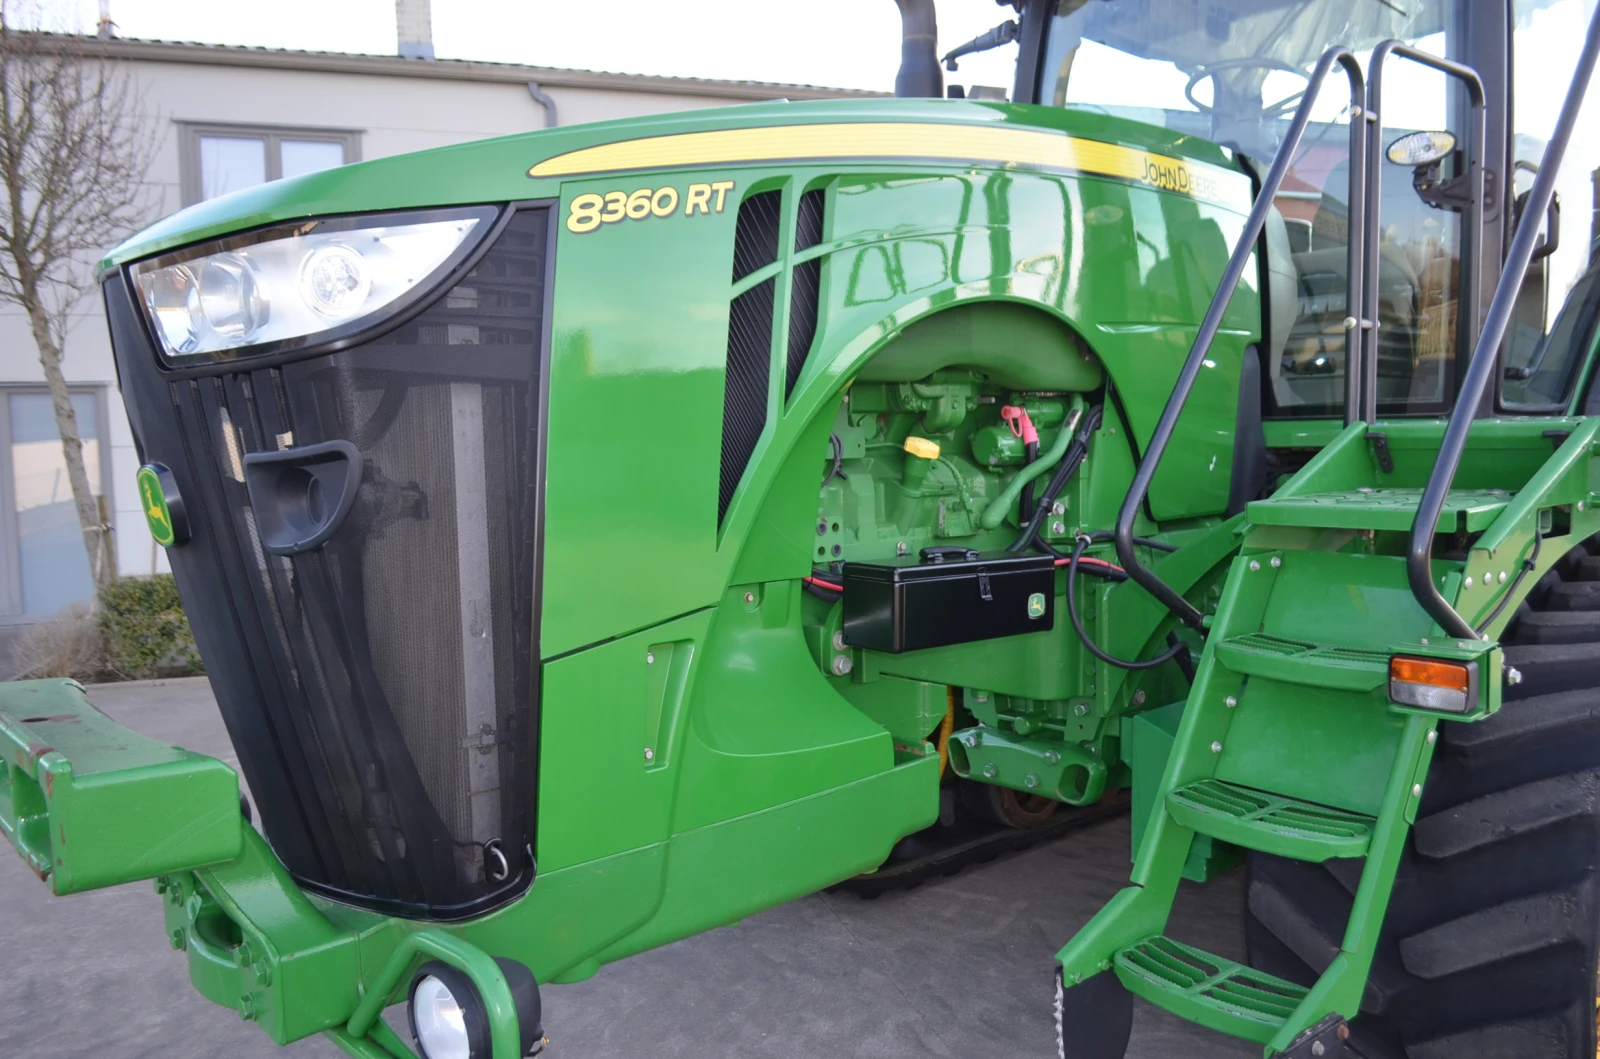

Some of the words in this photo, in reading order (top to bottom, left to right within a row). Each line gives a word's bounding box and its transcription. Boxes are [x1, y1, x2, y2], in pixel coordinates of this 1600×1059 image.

[1141, 157, 1177, 189] JOHN
[566, 185, 680, 234] 8360
[684, 180, 735, 217] RT
